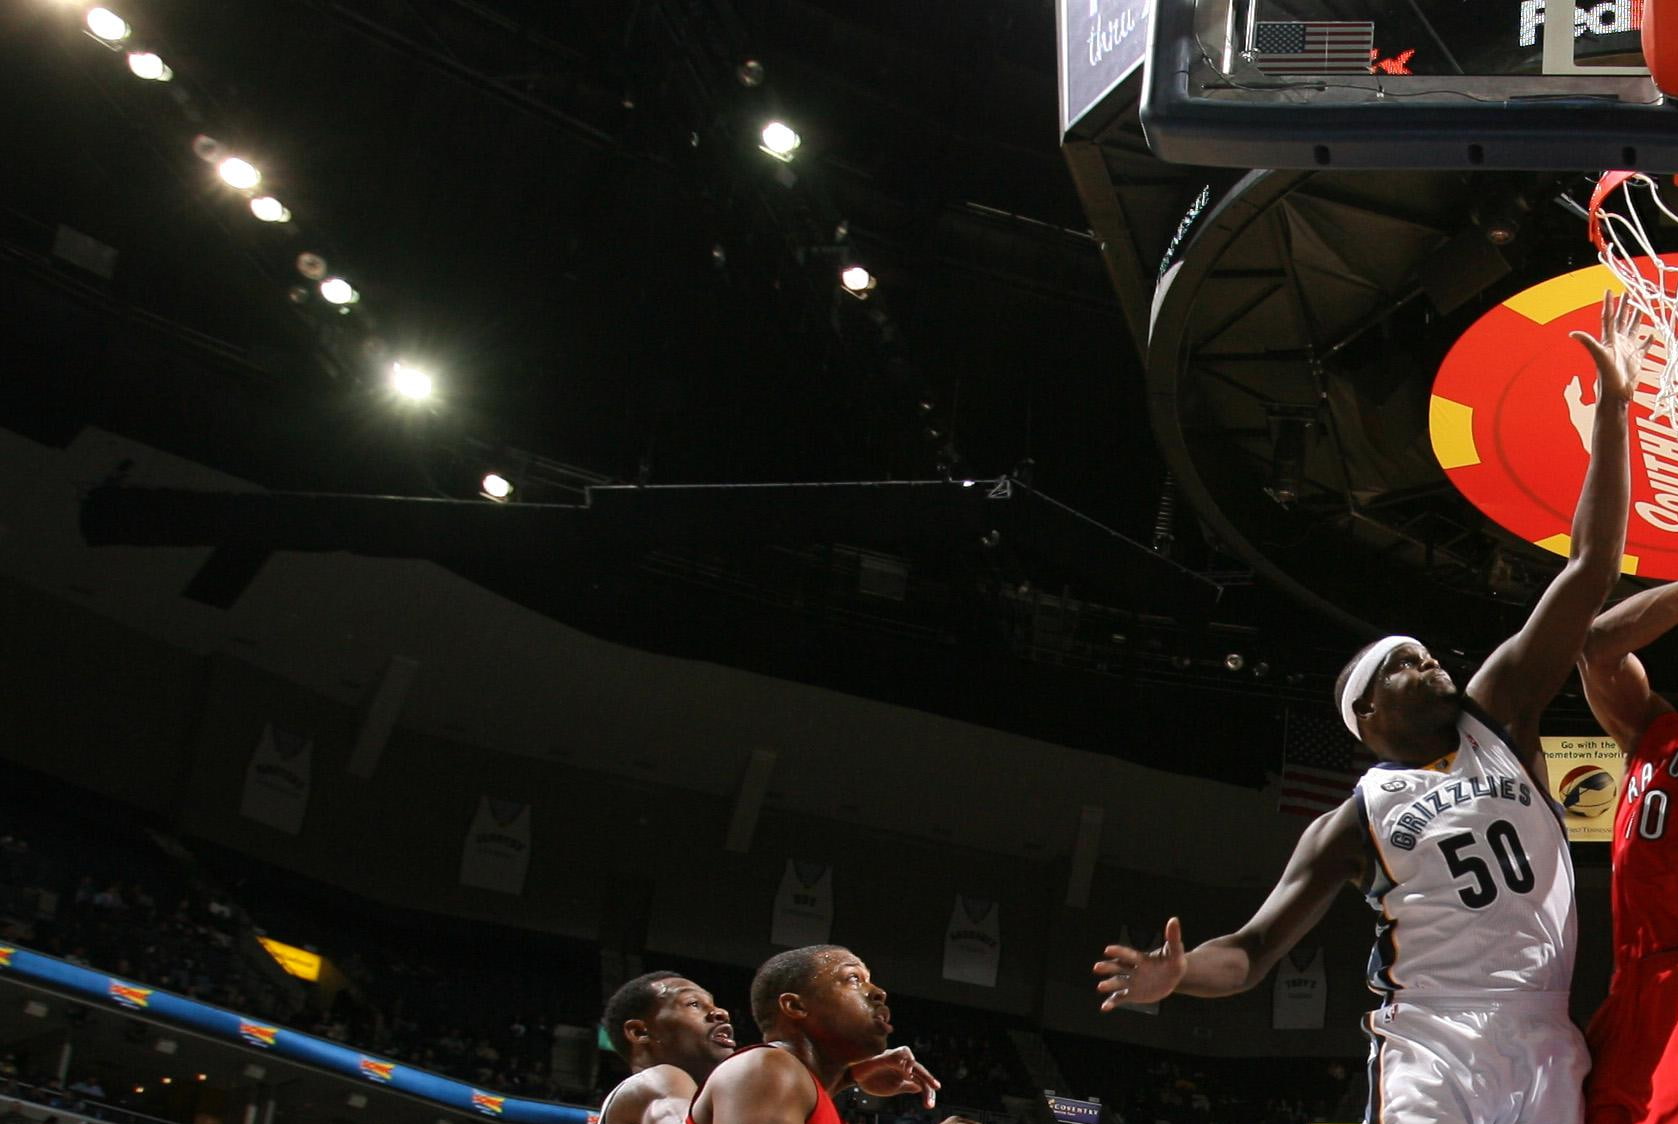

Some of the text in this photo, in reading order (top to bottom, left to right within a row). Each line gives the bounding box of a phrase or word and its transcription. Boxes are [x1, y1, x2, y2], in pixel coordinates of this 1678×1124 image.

[1561, 741, 1616, 749] Go with the
[1390, 776, 1531, 851] GRIZZLIES
[1437, 820, 1535, 909] 50
